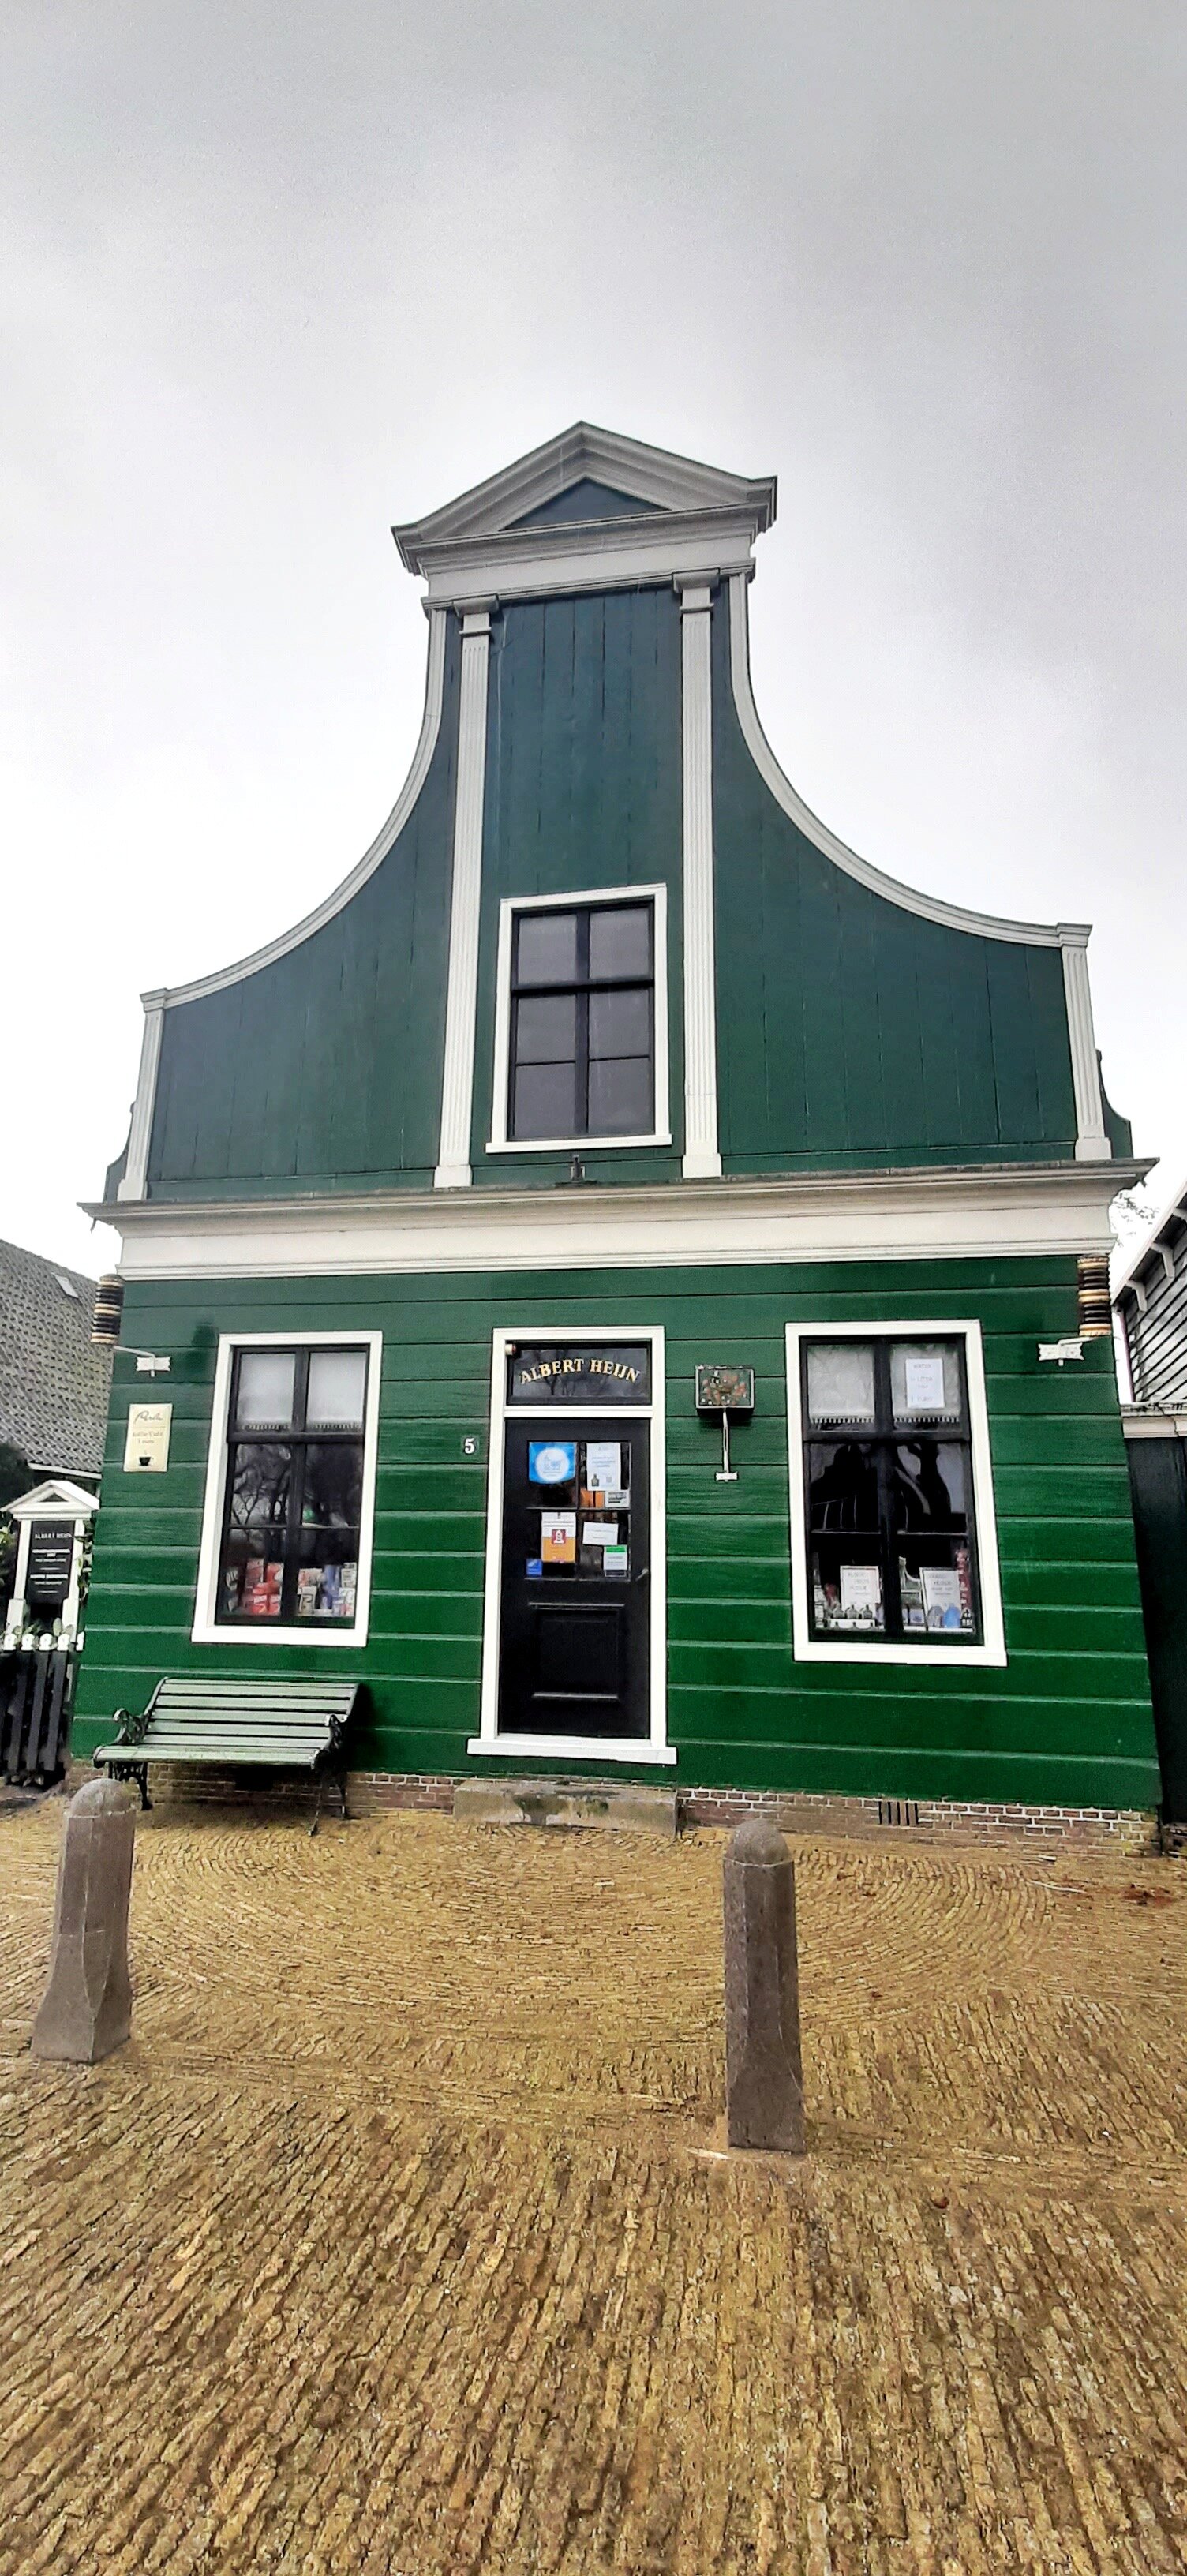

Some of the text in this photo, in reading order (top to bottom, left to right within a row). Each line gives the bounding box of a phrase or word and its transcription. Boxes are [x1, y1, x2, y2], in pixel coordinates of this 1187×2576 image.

[520, 1358, 641, 1385] ALBERT HEIJN
[464, 1437, 475, 1454] 5
